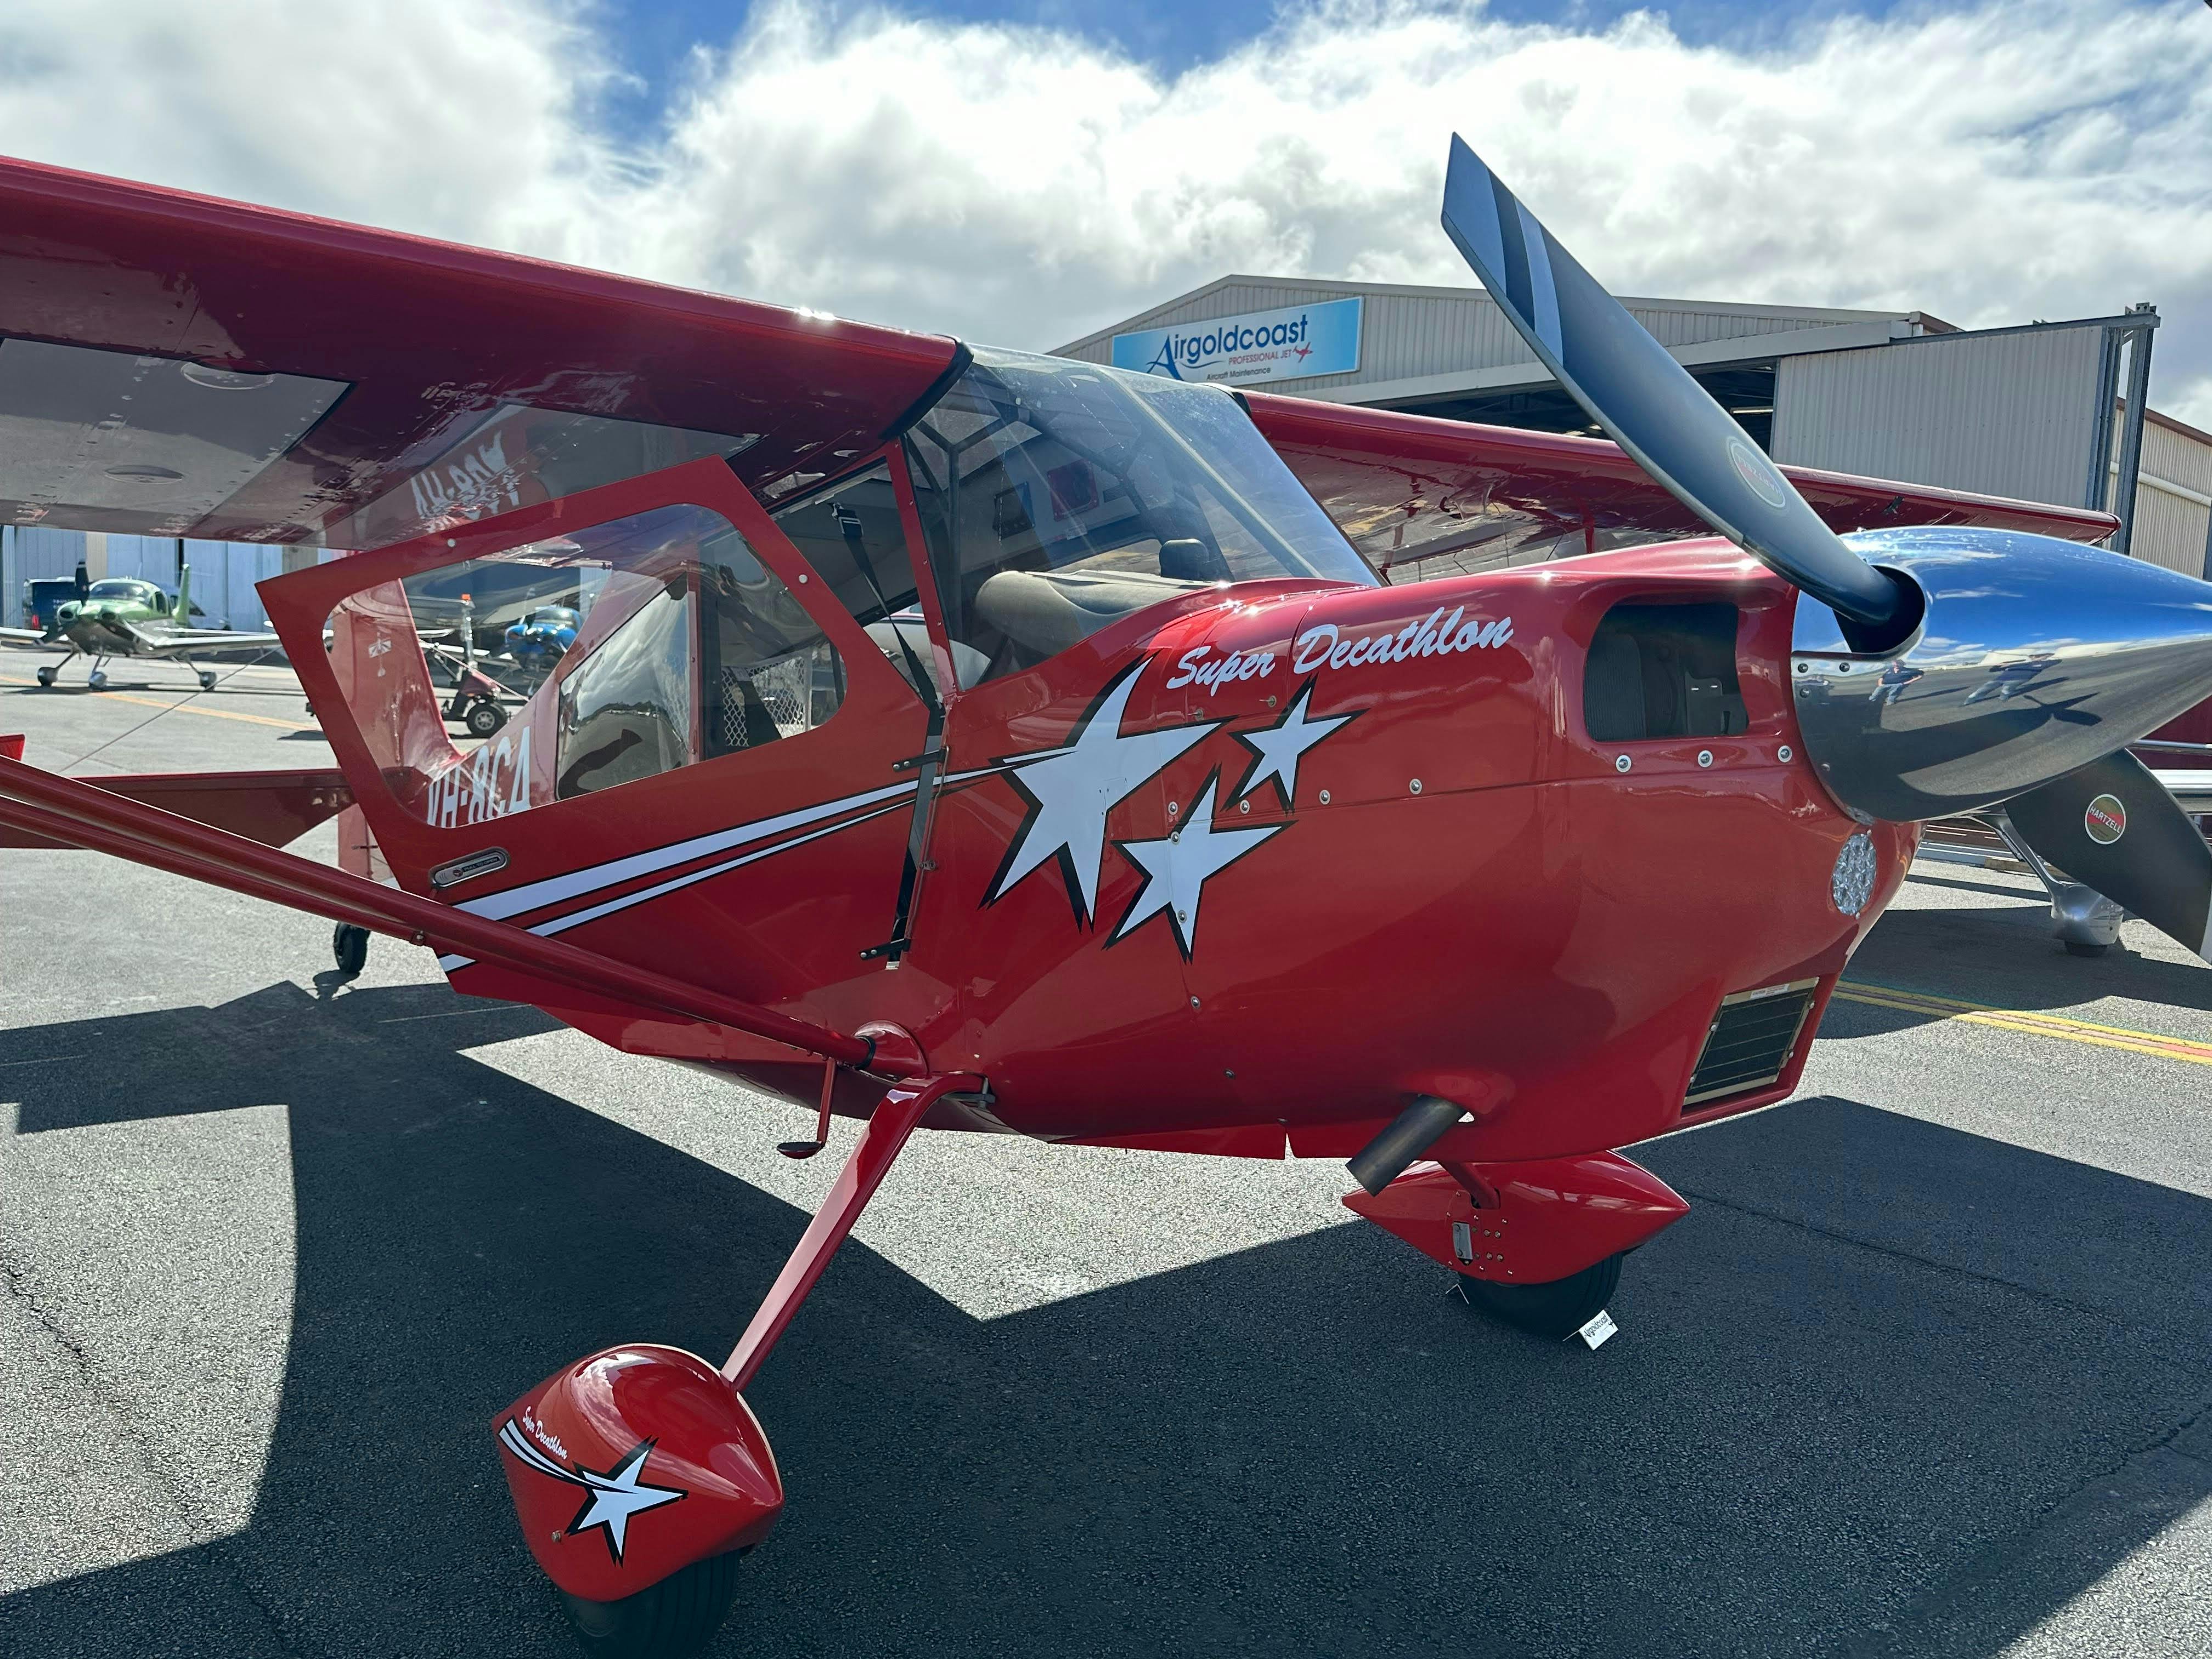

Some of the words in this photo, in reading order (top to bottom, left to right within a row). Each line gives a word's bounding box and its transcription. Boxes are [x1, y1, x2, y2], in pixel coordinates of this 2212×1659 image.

[1146, 314, 1308, 381] Airgoldcoast
[1228, 352, 1279, 365] PROFESSIONAL
[1280, 349, 1292, 358] JET
[1206, 371, 1228, 381] Aircraft
[1229, 367, 1271, 378] Maintenance
[1166, 646, 1276, 697] Super
[1294, 605, 1514, 675] Decathlon
[2089, 806, 2121, 834] HARTZELL
[535, 1420, 567, 1460] Decathlon
